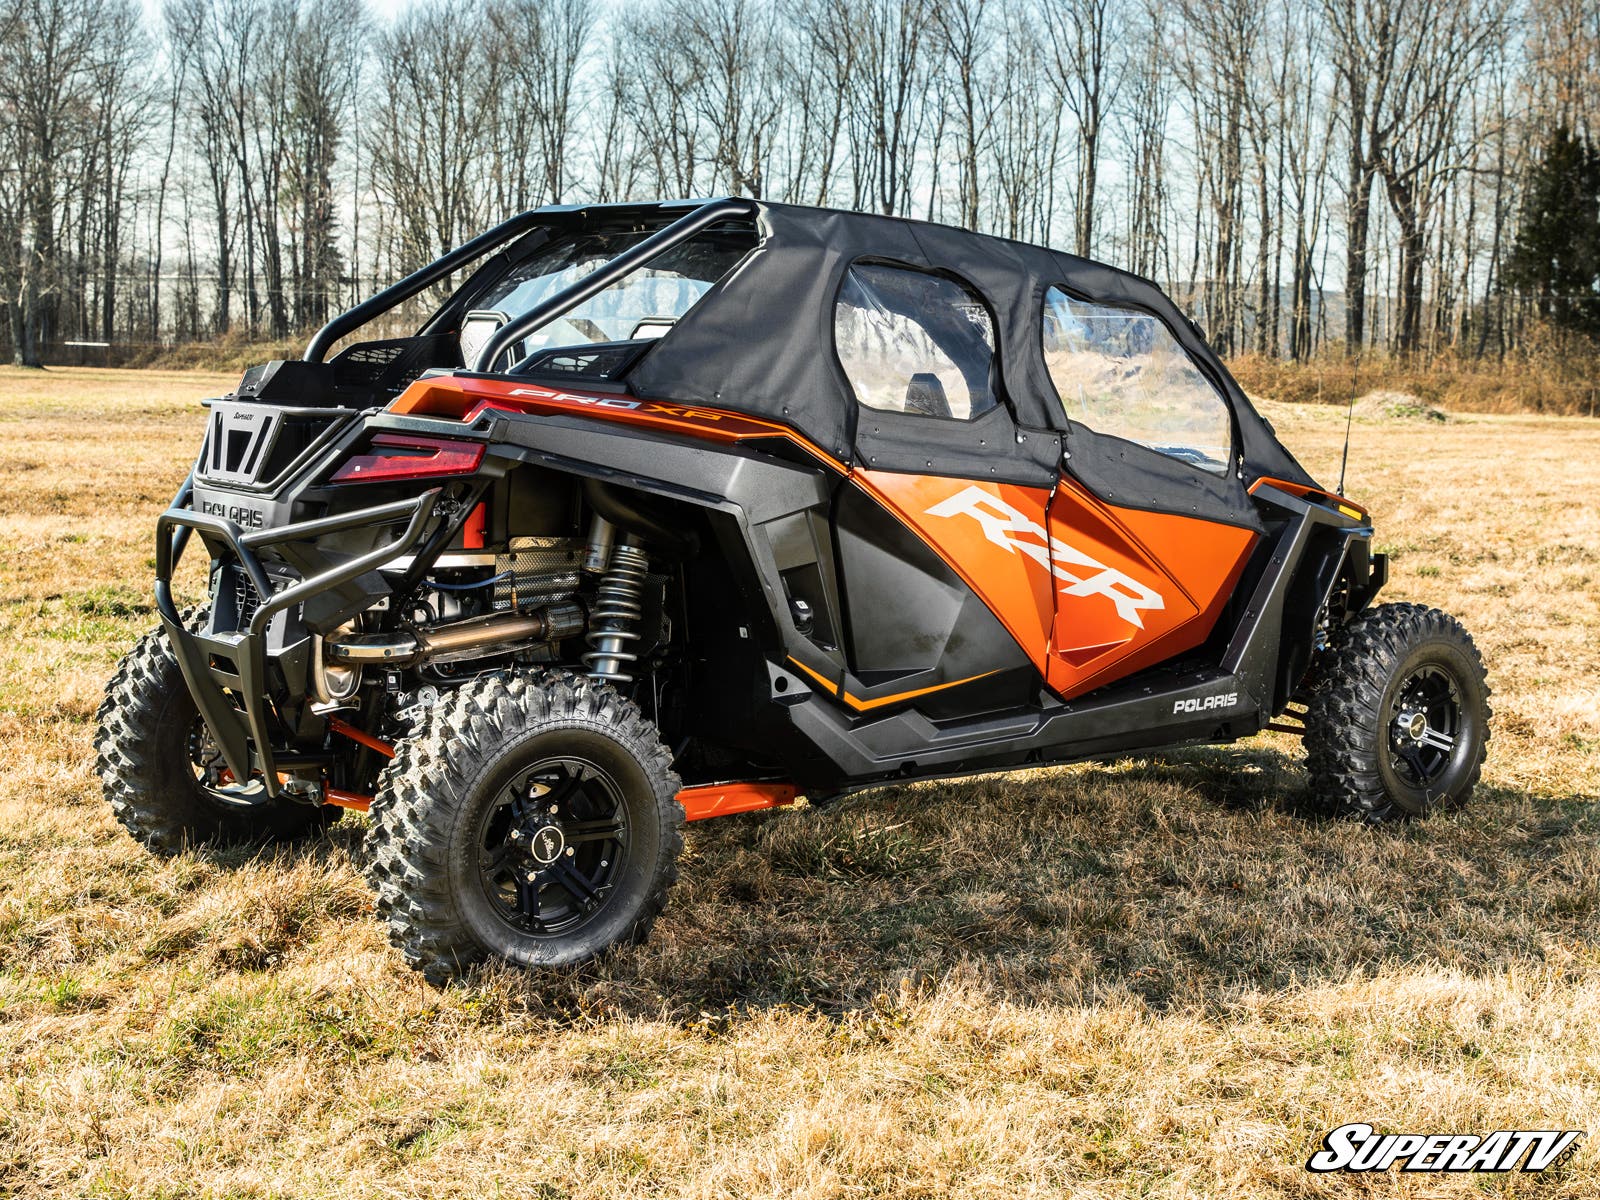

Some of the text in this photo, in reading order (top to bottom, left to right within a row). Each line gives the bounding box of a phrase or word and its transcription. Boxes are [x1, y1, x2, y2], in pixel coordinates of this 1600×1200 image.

[509, 388, 722, 421] PRO XP
[202, 501, 263, 528] POLARIS
[924, 485, 1165, 630] RZR
[1173, 693, 1238, 714] POLARIS
